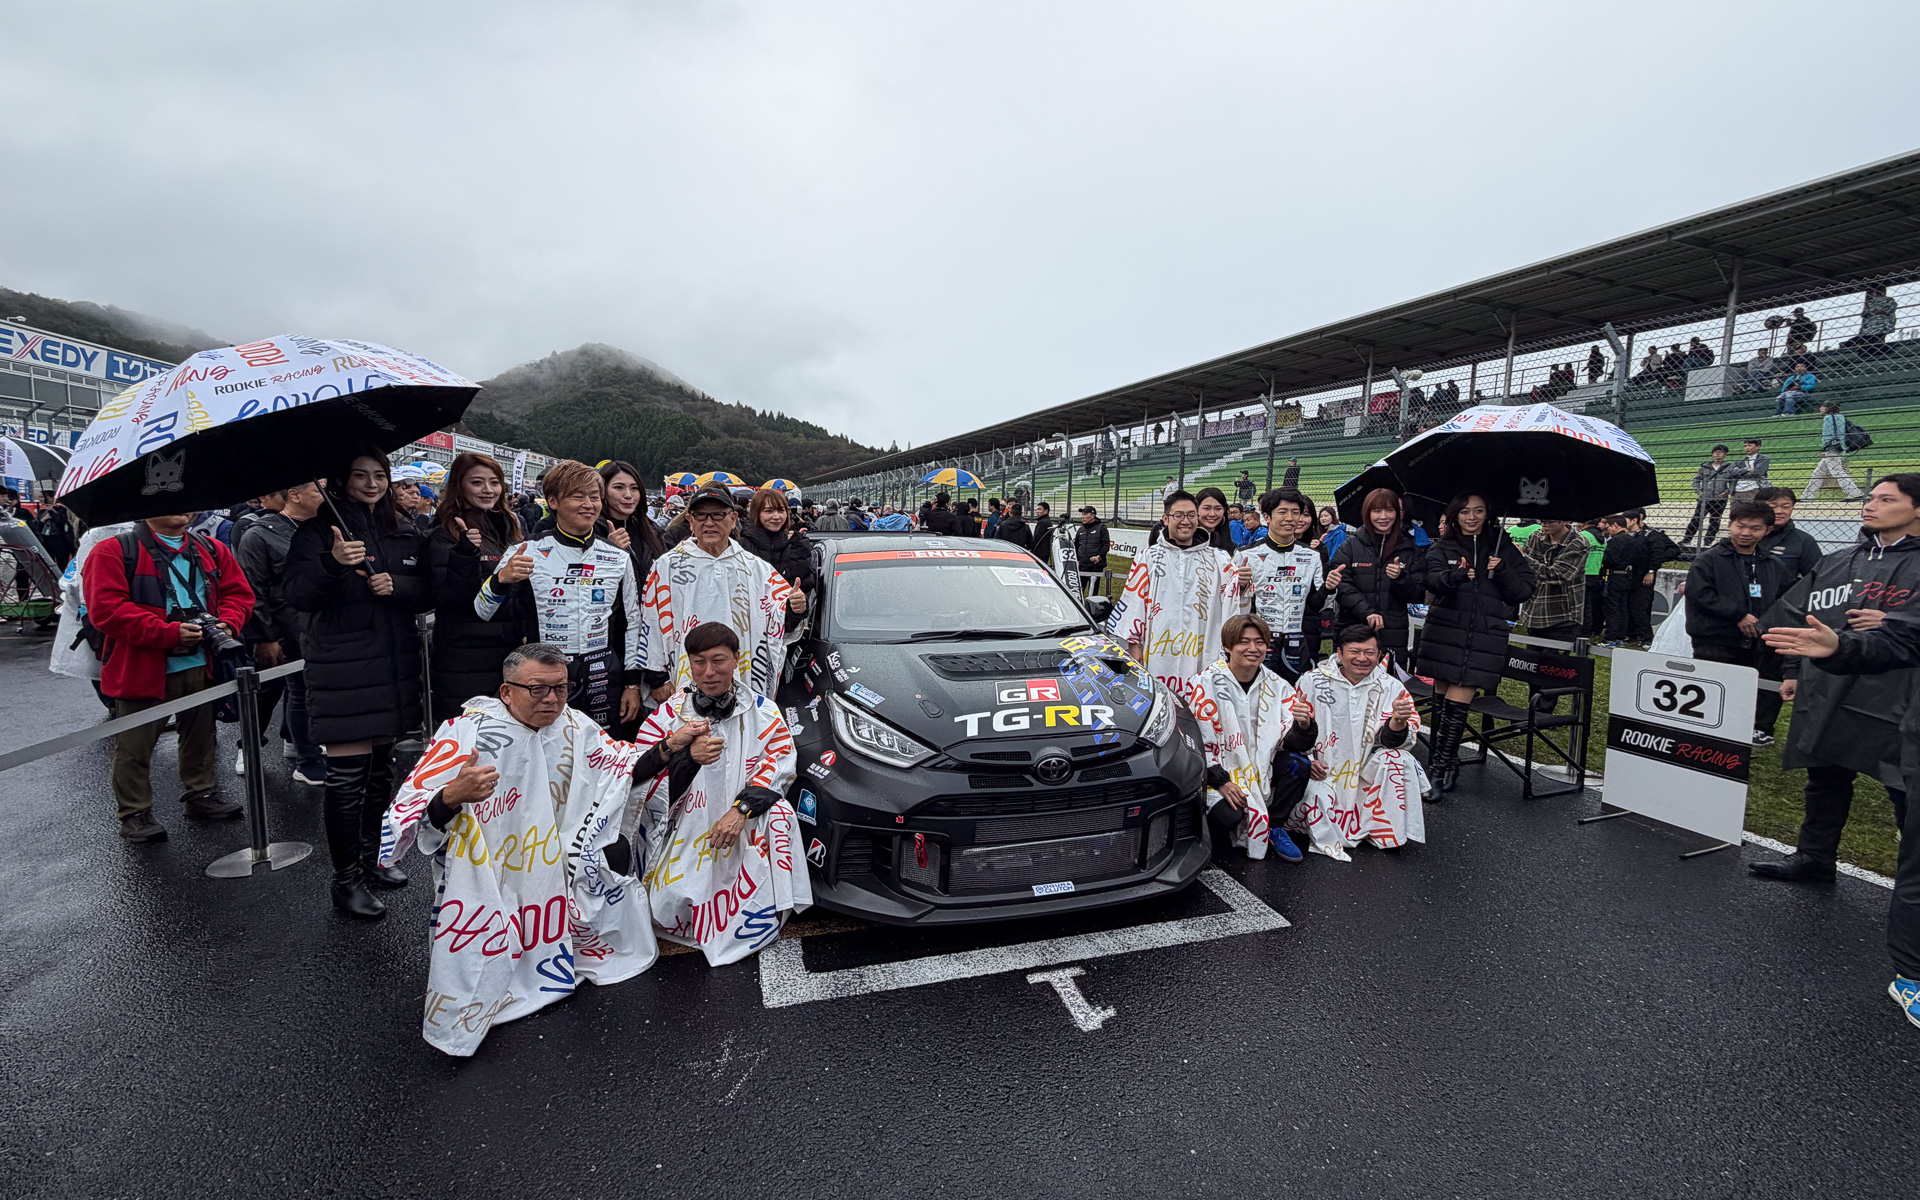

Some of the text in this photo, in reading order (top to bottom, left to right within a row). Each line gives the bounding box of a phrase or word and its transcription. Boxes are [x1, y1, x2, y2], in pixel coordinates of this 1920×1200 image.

[0, 327, 99, 372] EXEDY
[113, 355, 170, 381] エクセ
[215, 364, 326, 395] ROOKIE RACING
[912, 550, 982, 558] ENEOS
[1062, 549, 1076, 560] 32
[1110, 540, 1138, 557] Racing
[552, 577, 605, 585] TG-RR
[567, 567, 594, 578] GR
[1508, 657, 1577, 679] ROOKIE RACING
[999, 685, 1058, 703] GR
[1652, 679, 1706, 719] 32
[954, 704, 1116, 738] TG-RR
[1620, 728, 1742, 770] ROOKIE RACING
[1045, 885, 1073, 893] CLUTCH
